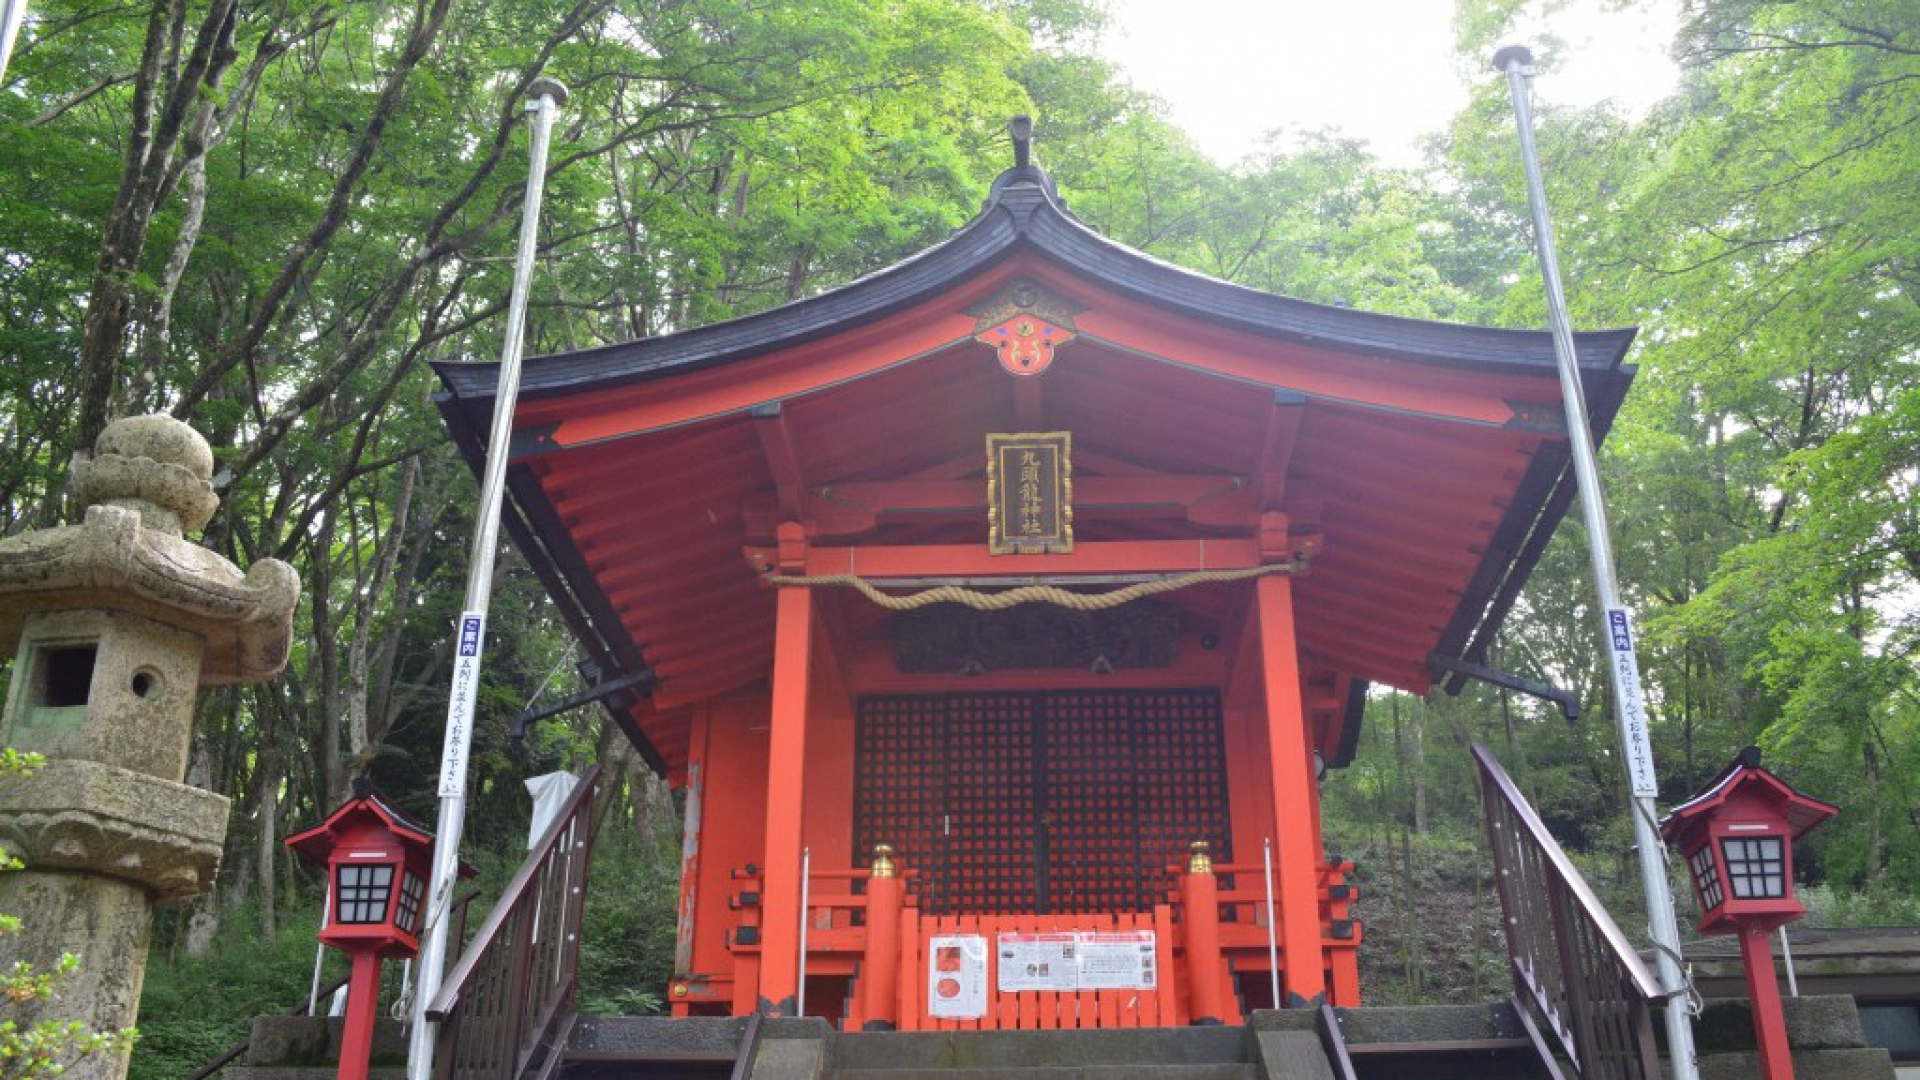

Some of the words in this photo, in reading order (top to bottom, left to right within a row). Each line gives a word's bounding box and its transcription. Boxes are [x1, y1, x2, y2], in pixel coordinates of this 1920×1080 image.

[463, 619, 478, 655] ご案内
[1613, 613, 1629, 650] ご案内
